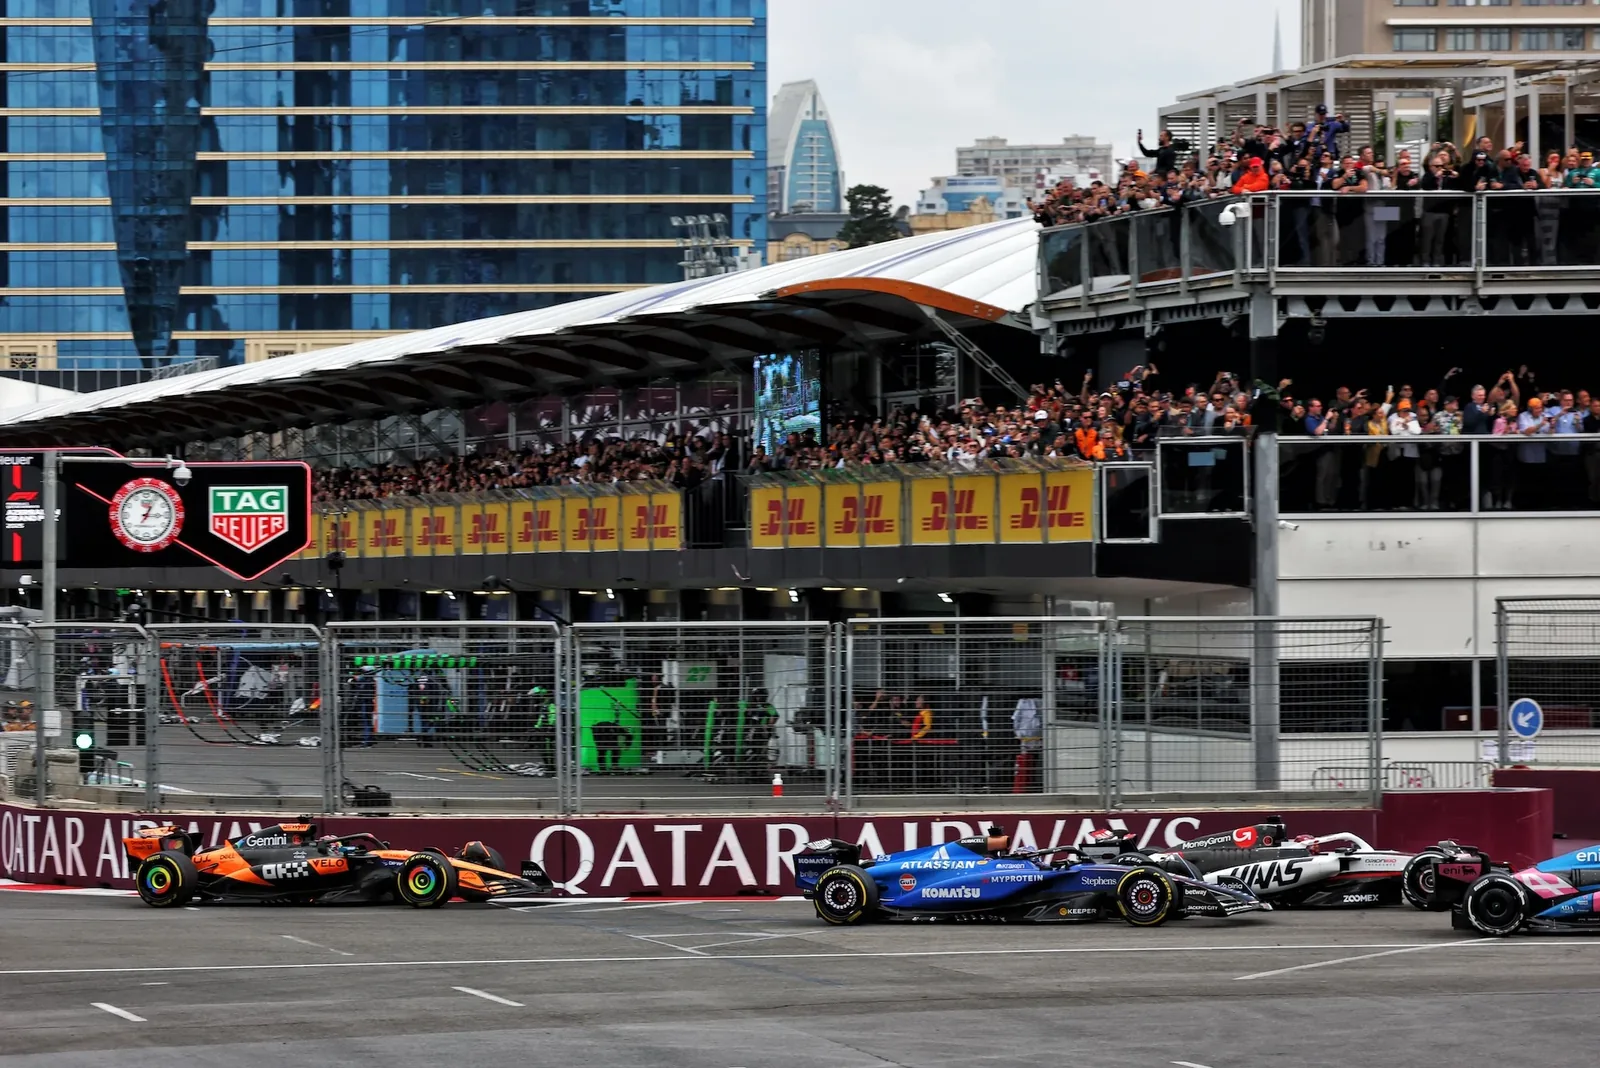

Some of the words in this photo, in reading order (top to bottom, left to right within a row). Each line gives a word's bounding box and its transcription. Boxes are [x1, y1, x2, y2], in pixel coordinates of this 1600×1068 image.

[216, 491, 281, 511] TAG
[925, 490, 985, 530] DHL
[1014, 485, 1081, 528] DHL
[632, 505, 674, 538] DHL
[762, 498, 813, 535] DHL
[837, 495, 891, 533] DHL
[213, 515, 284, 546] HEUER
[1, 810, 88, 878] QATAR
[246, 833, 287, 847] Gemini
[1182, 835, 1231, 849] MoneyGram
[312, 859, 345, 868] VELO
[530, 823, 811, 895] QATAR
[877, 854, 891, 862] 23
[900, 860, 975, 870] ATLASSIAN
[262, 861, 309, 880] OKX
[991, 875, 1044, 883] MYPROTEIN
[1229, 858, 1313, 890] HAAS
[1443, 866, 1460, 875] eni
[1081, 876, 1117, 887] Stephens
[922, 885, 980, 898] KOMATSU
[1343, 893, 1379, 903] ZOOMEX
